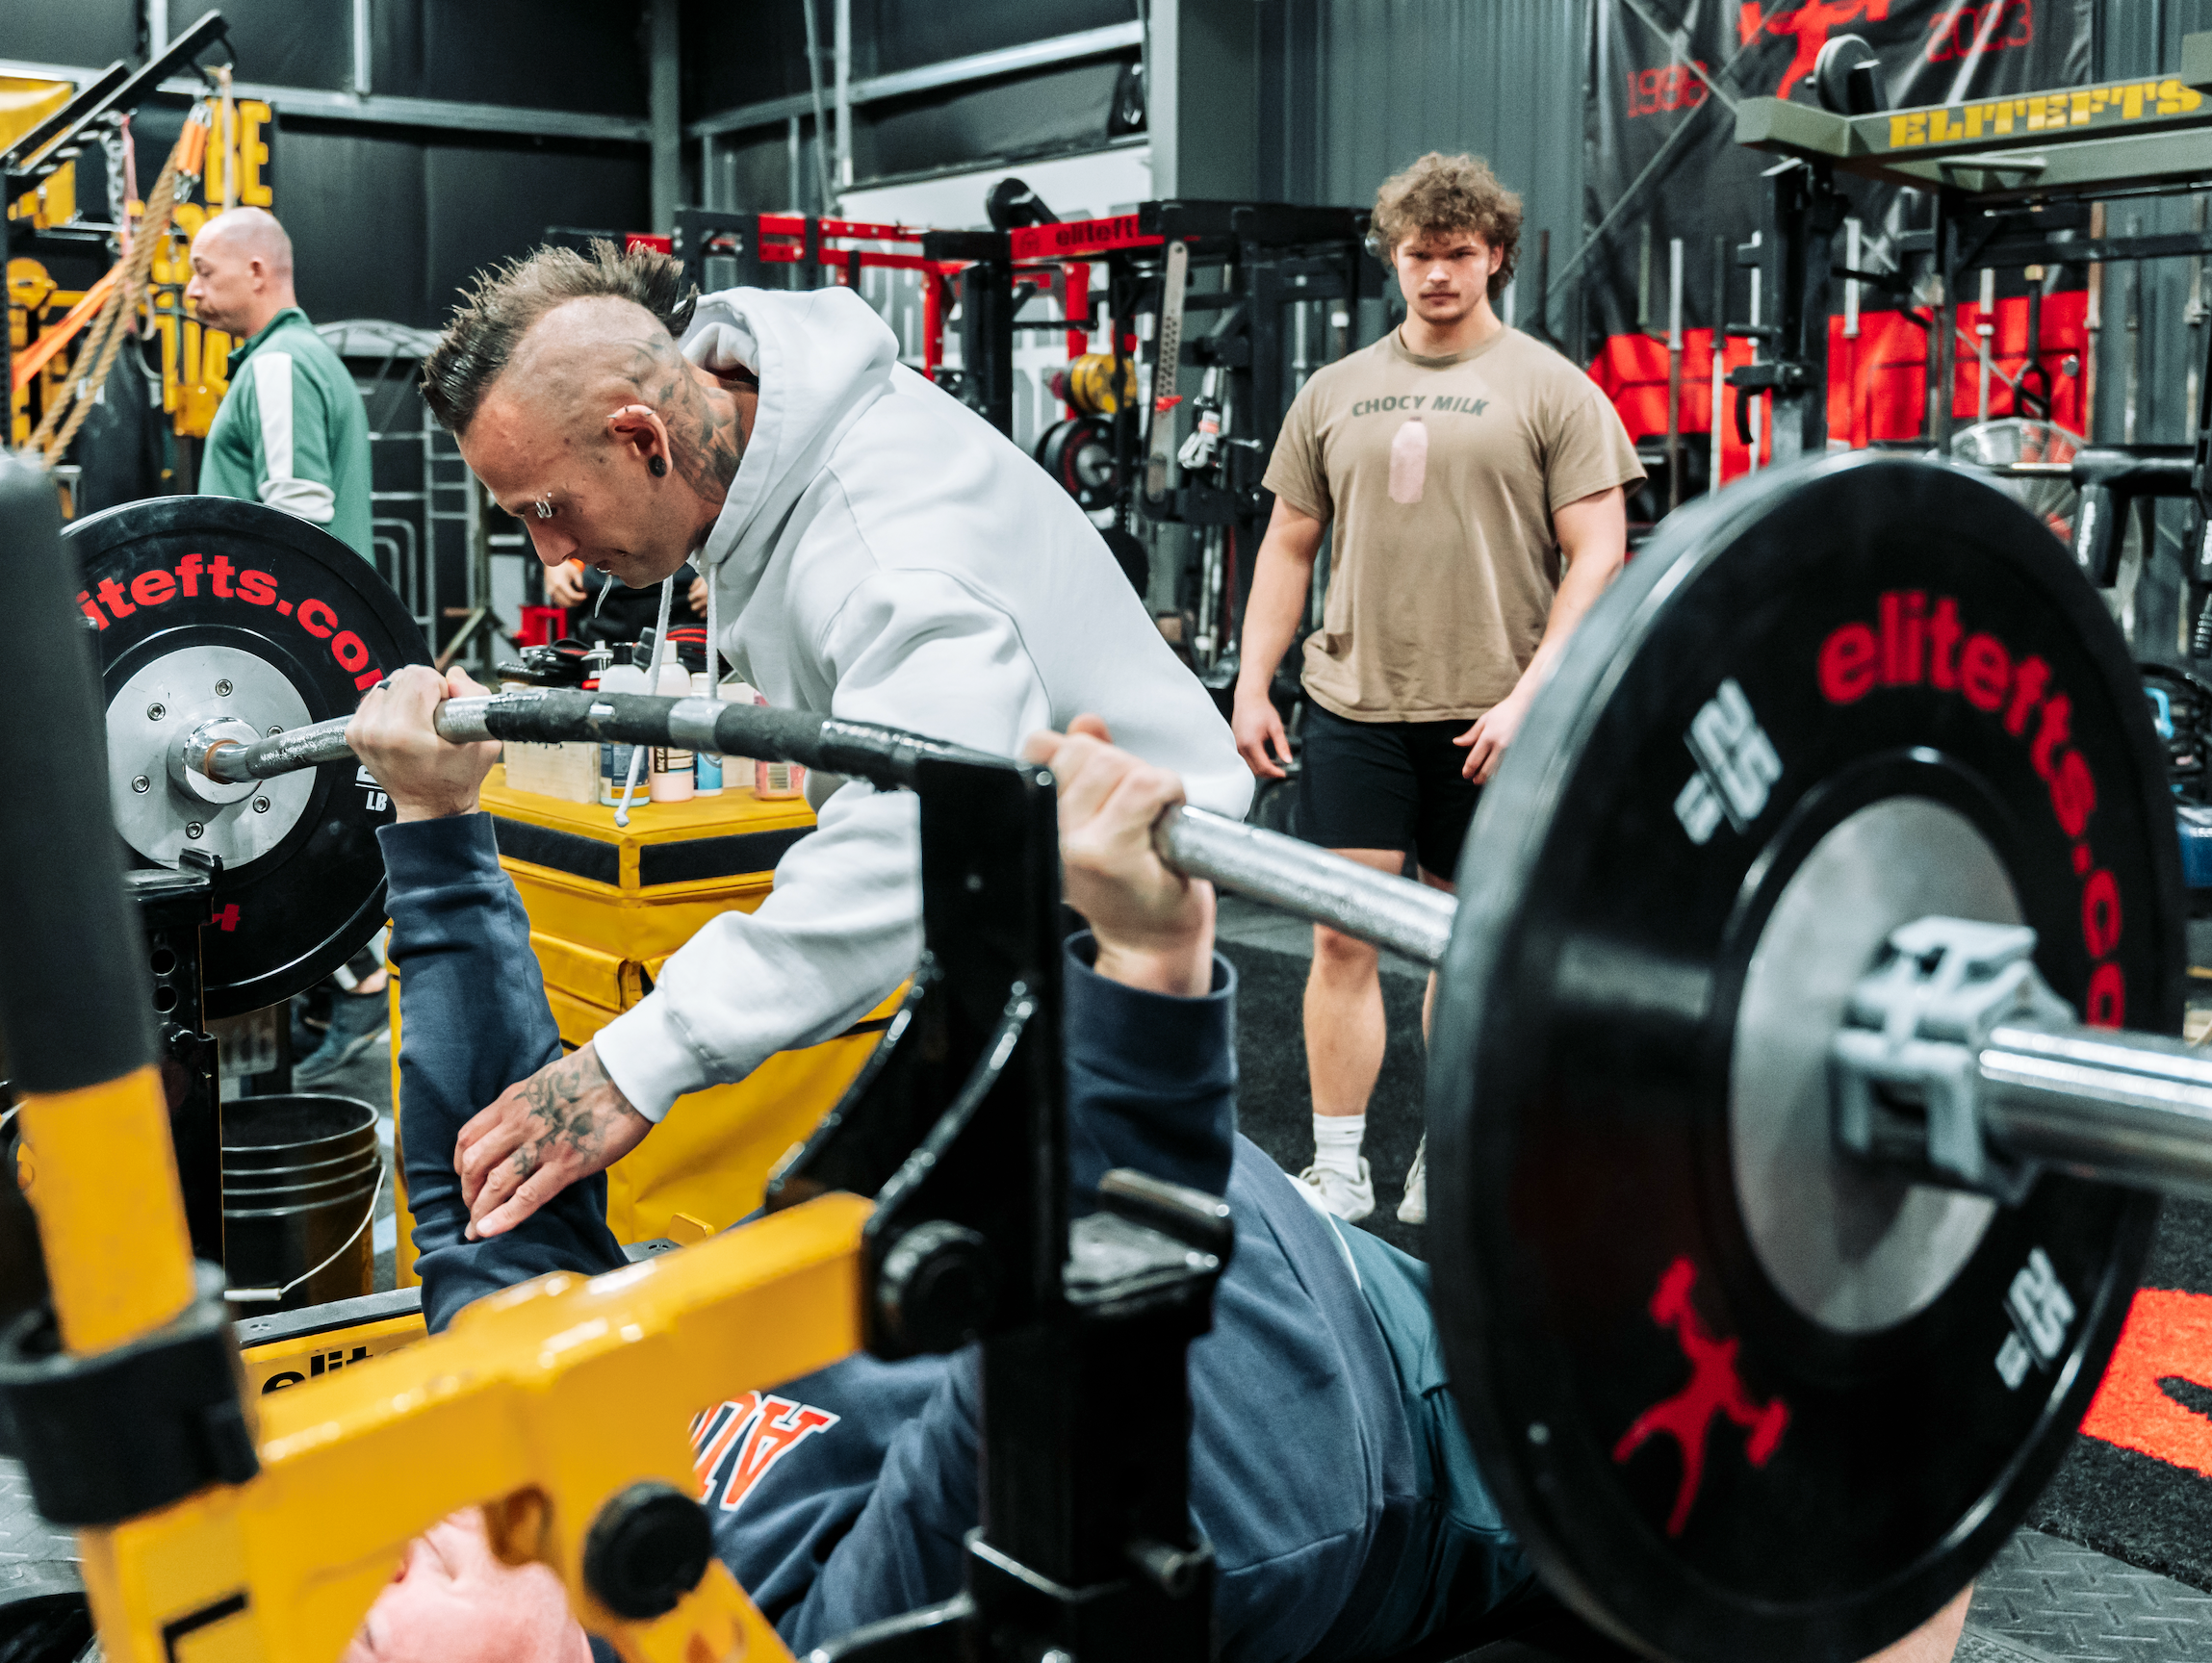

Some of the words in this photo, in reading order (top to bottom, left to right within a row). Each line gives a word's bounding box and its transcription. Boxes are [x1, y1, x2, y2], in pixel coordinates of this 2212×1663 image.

[1925, 0, 2033, 63] 2023
[1889, 78, 2202, 148] ELITEFTS
[1055, 217, 1134, 246] eliteft
[1351, 395, 1427, 418] CHOCY
[1430, 395, 1490, 417] MILK
[76, 553, 384, 691] itefts.co
[366, 790, 388, 812] LB
[1817, 590, 2125, 1032] elitefts.co
